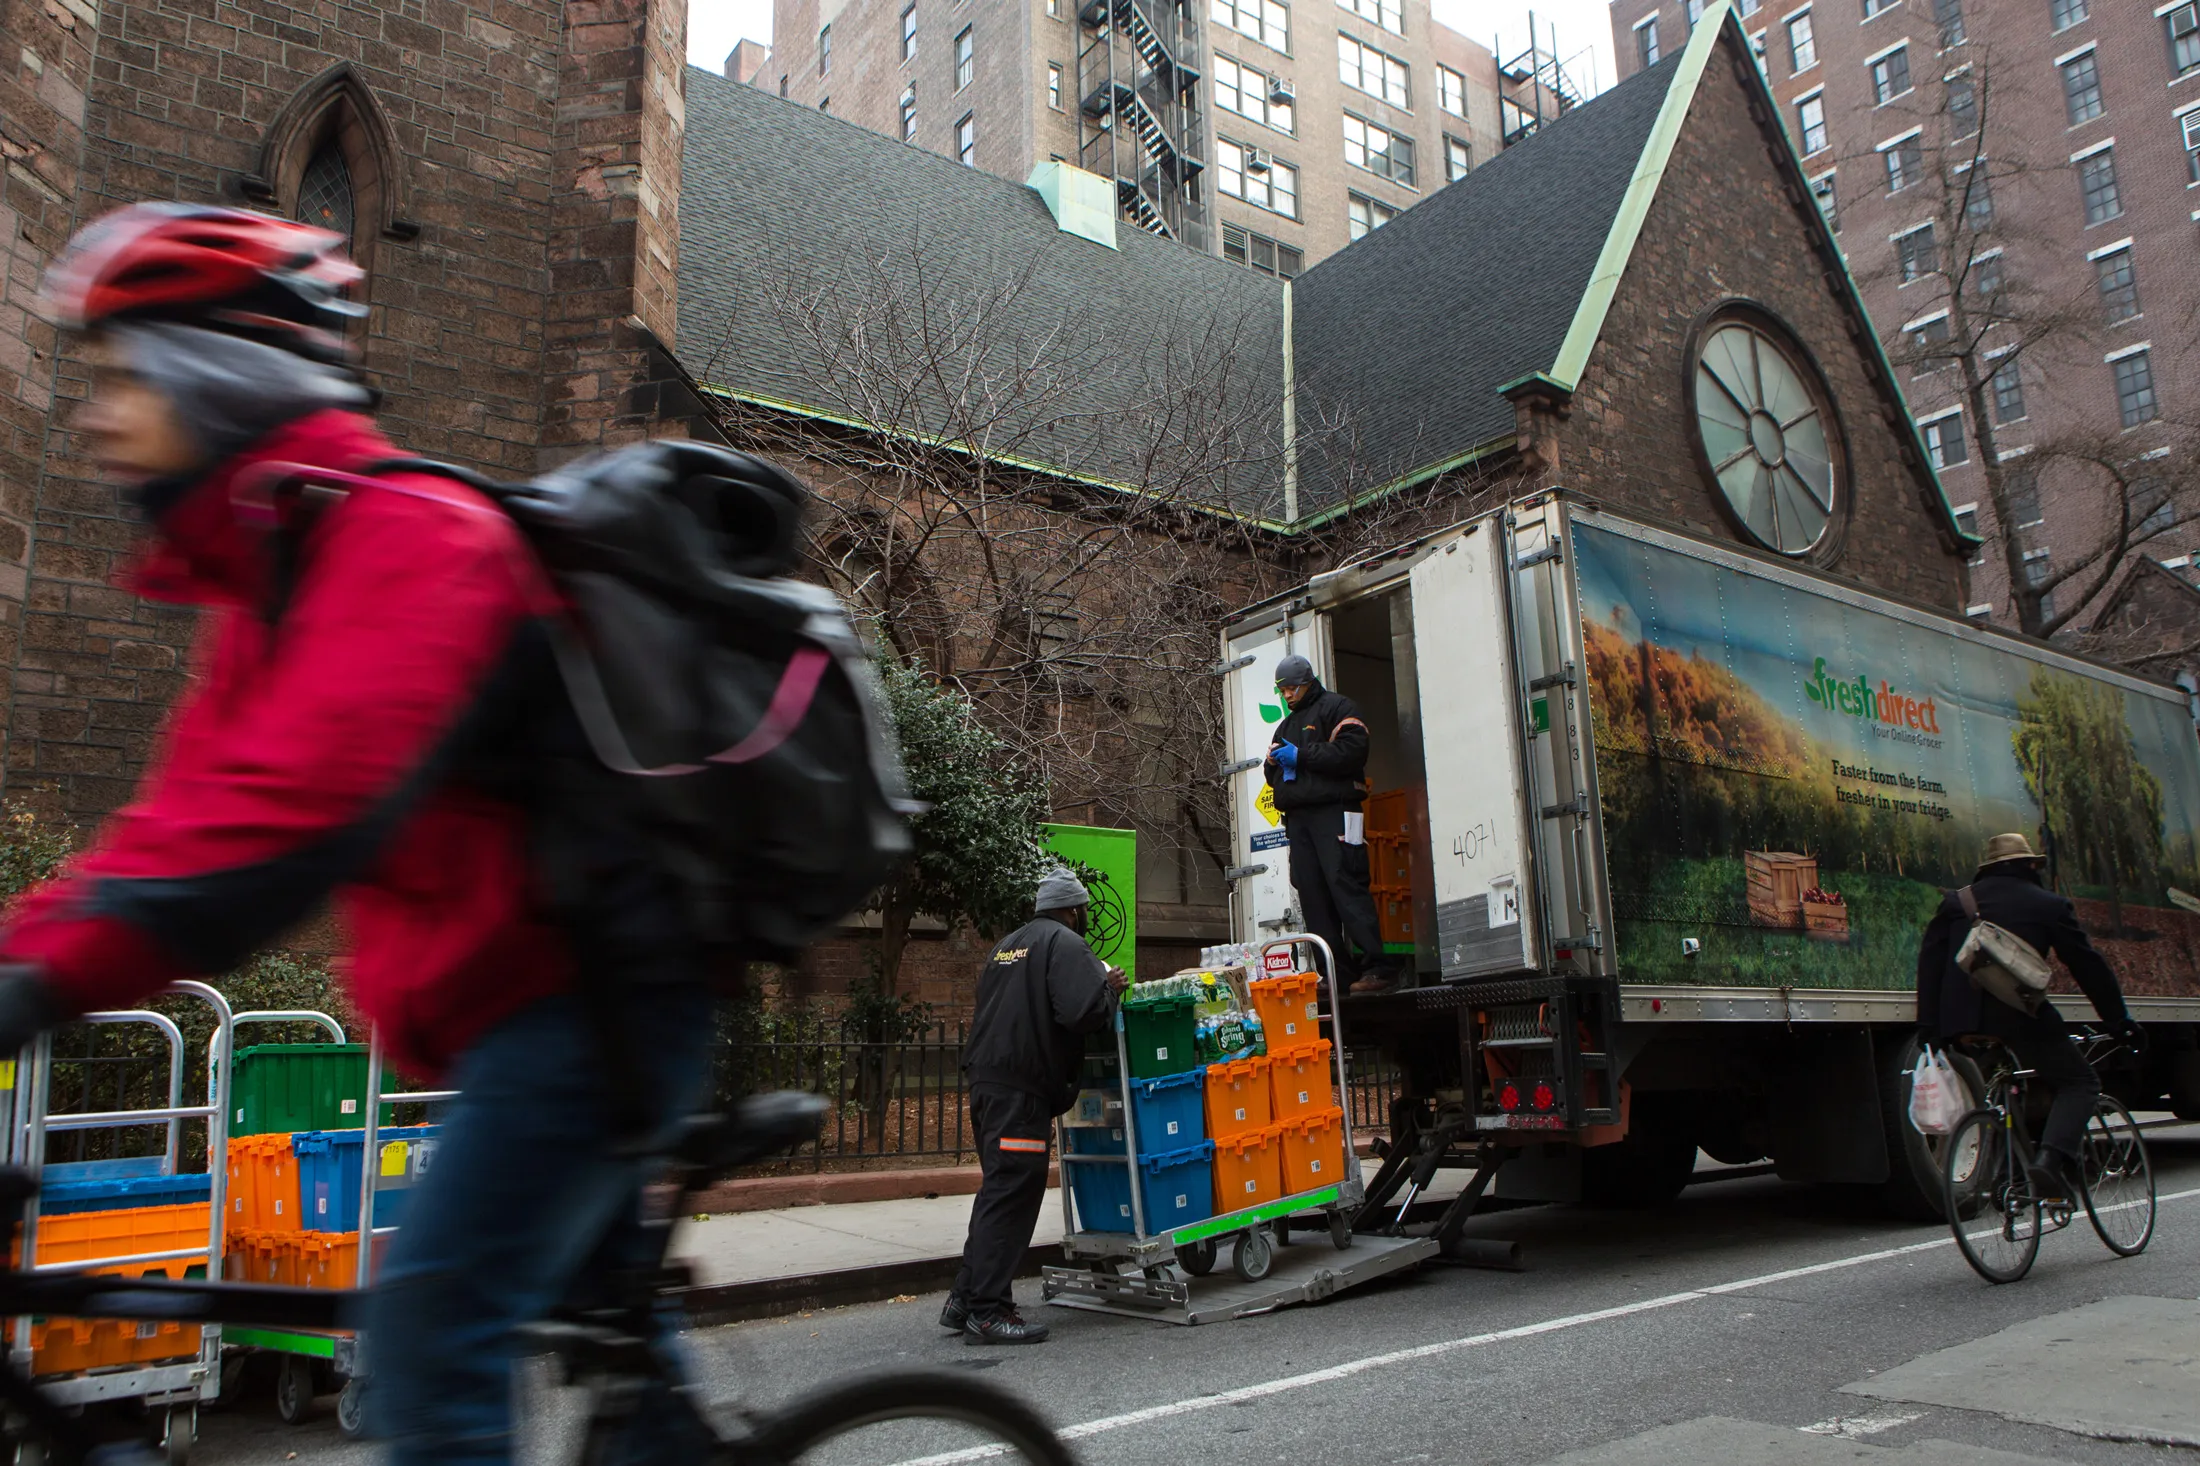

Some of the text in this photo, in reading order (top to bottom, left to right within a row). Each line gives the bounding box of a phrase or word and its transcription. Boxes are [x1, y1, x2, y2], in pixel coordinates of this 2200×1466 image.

[1813, 656, 1941, 734] freshdirect
[1870, 723, 1943, 750] Your Online Grocer
[1831, 759, 1947, 798] Faster from the farm,
[1836, 785, 1954, 821] fresher in your fridge.
[1453, 818, 1497, 868] 4071
[1266, 956, 1290, 969] Kidron
